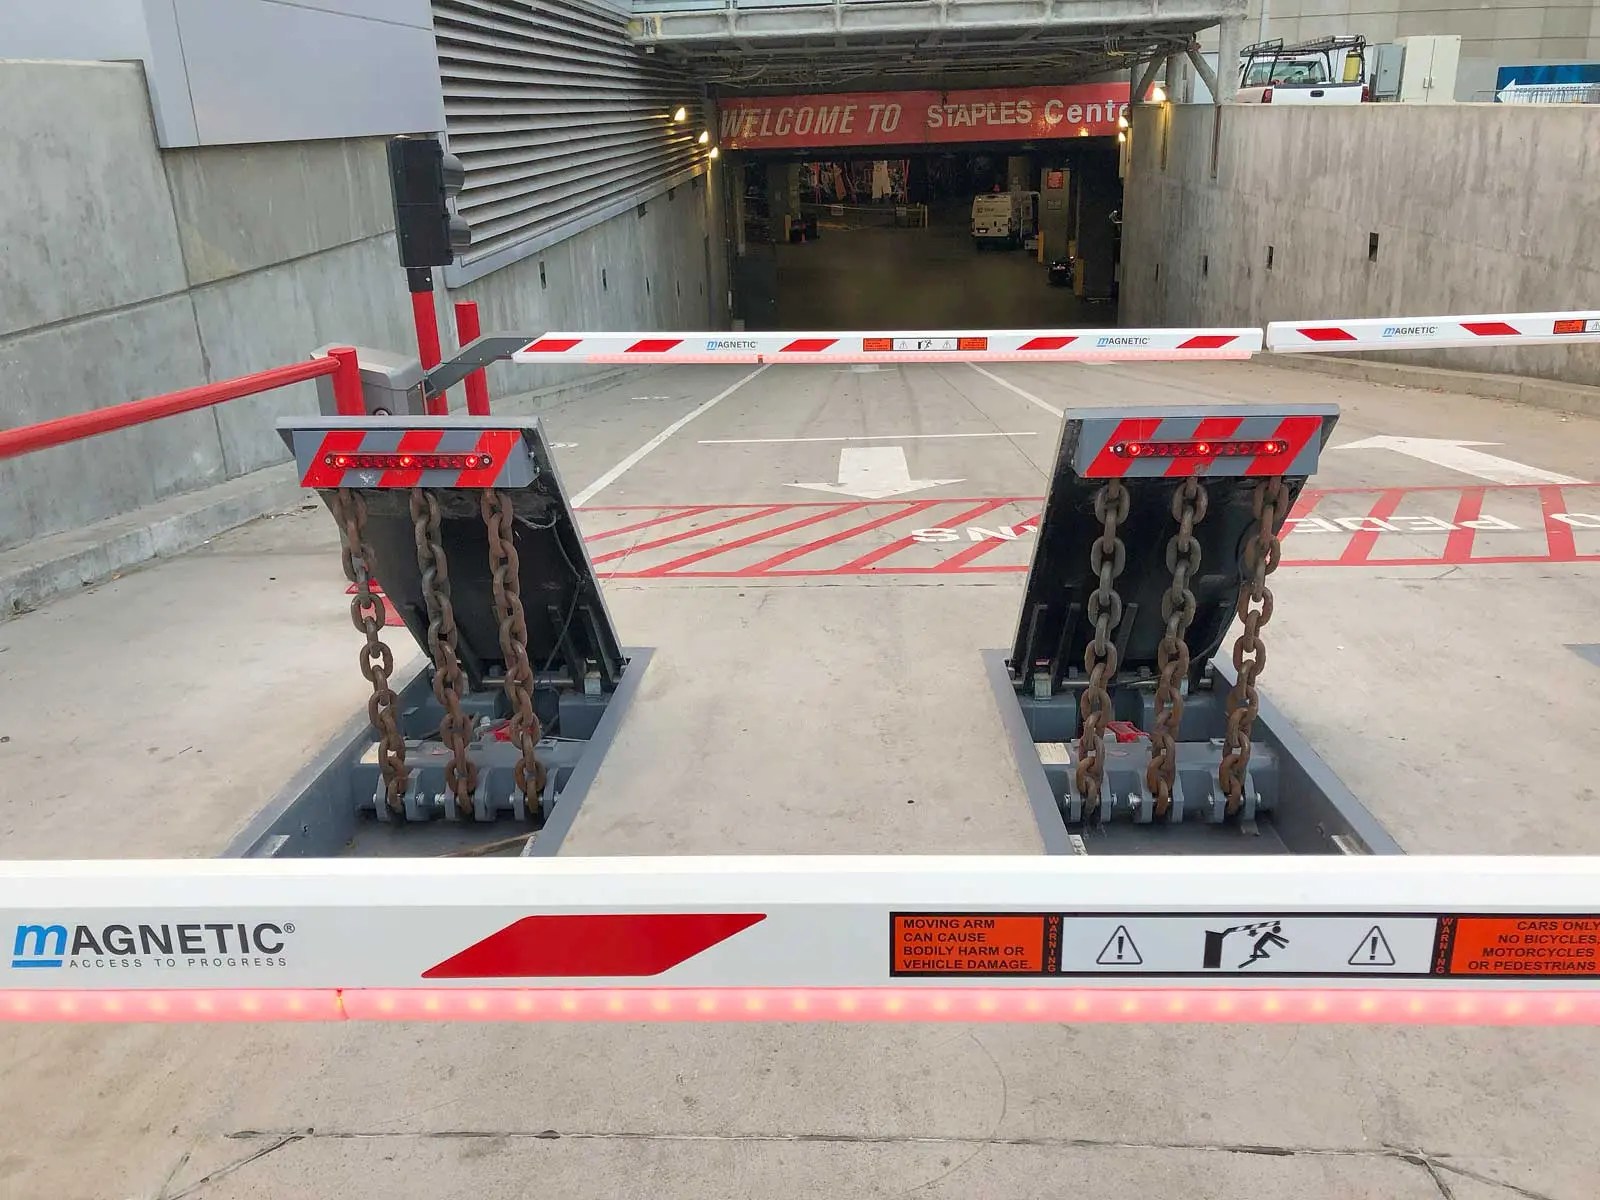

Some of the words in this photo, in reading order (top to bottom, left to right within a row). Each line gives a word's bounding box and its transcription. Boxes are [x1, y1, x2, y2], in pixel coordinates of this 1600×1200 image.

[720, 105, 858, 138] WELCOME
[867, 103, 902, 133] TO
[927, 100, 1033, 128] STAPLES
[1044, 99, 1130, 124] Cent
[903, 919, 960, 929] MOVING
[963, 919, 995, 928] ARM
[1517, 921, 1558, 931] CARS
[1562, 921, 1600, 931] ONLY
[903, 932, 933, 942] CAN
[937, 932, 987, 942] CAUSE
[1498, 934, 1520, 944] NO
[1048, 916, 1060, 973] WARNING
[1436, 917, 1453, 974] WARNING
[903, 946, 954, 956] BODILY
[958, 946, 1000, 956] HARM
[1004, 946, 1025, 956] OR
[1482, 947, 1595, 958] MOTORCYCLES
[69, 958, 142, 969] ACCESS
[156, 958, 176, 968] TO
[188, 957, 287, 967] PROGRESS
[903, 959, 963, 969] VEHICLE
[967, 959, 1033, 969] DAMAGE.
[1468, 960, 1489, 970] OR
[1493, 961, 1596, 971] PEDESTRIANS
